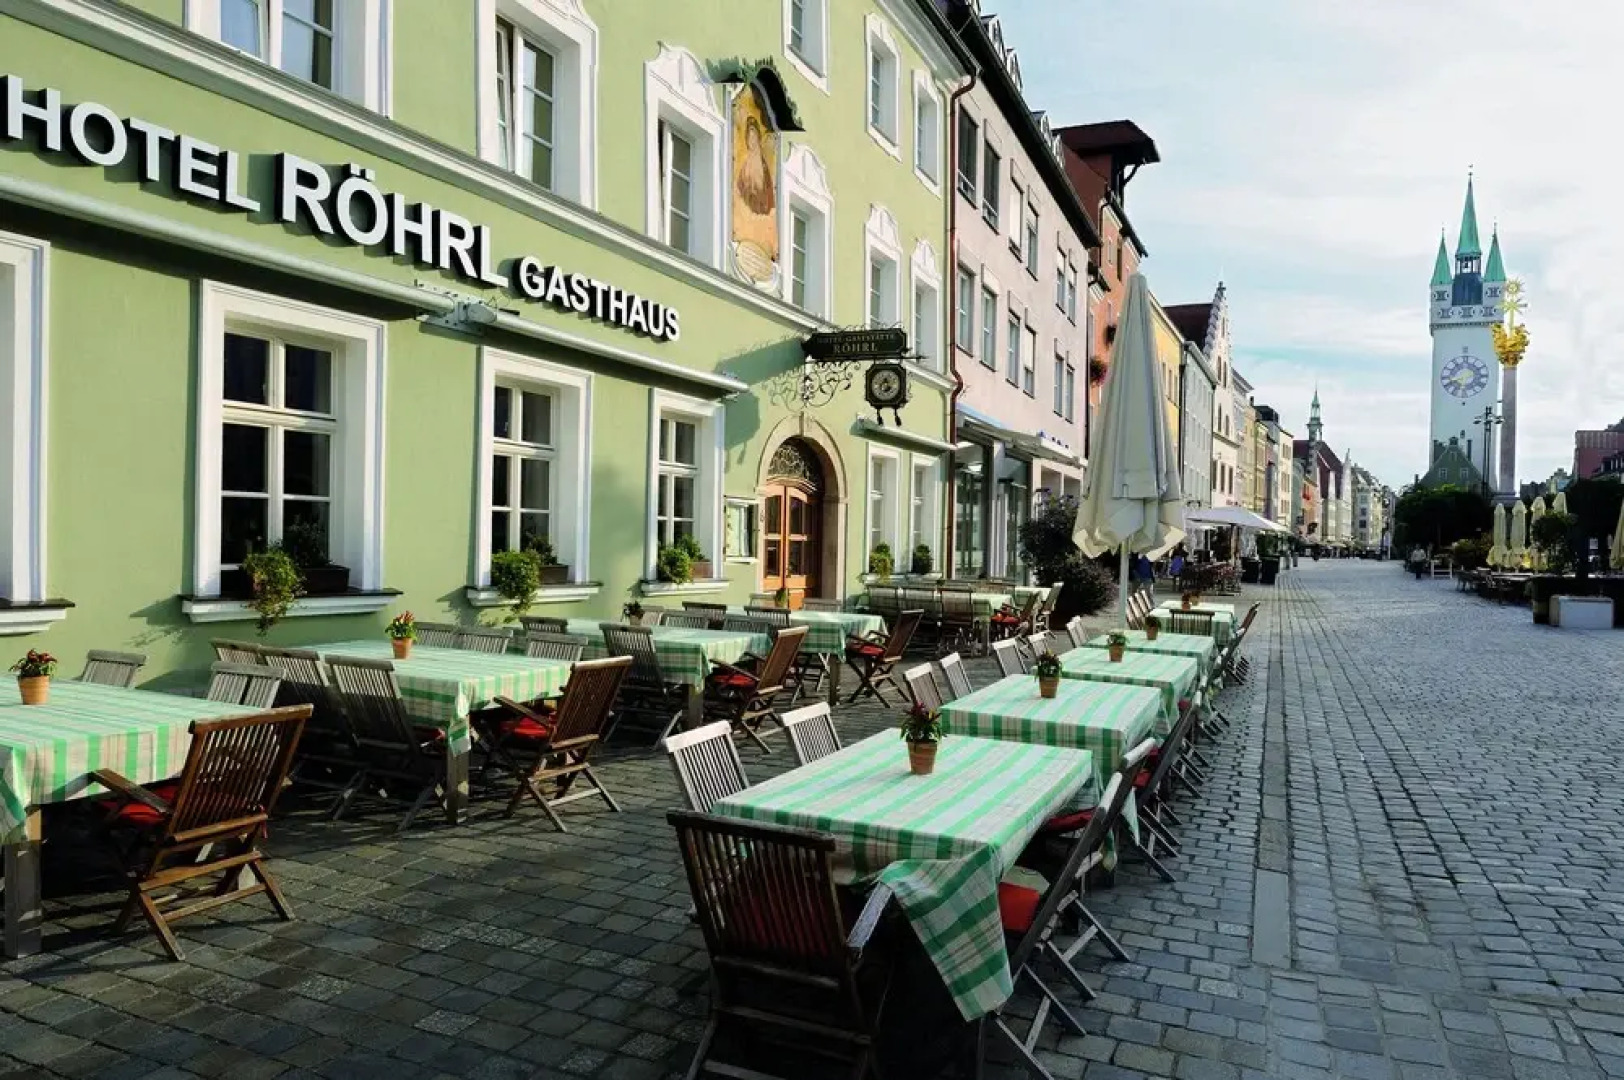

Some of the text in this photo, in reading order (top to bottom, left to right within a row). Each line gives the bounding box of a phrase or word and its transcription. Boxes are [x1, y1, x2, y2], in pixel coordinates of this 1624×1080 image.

[6, 74, 680, 342] HOTEL RÖHRL GASTHAUS
